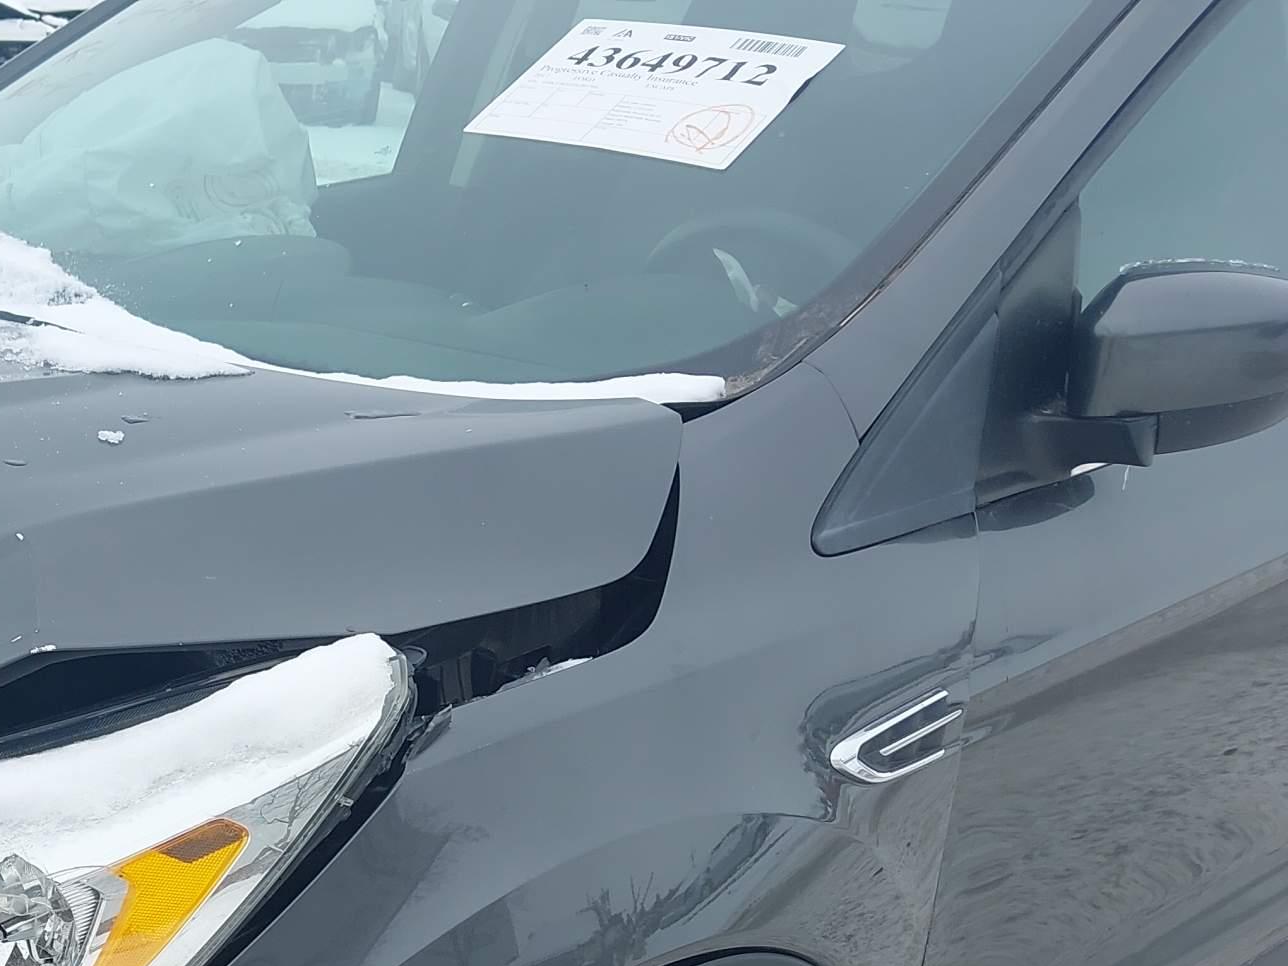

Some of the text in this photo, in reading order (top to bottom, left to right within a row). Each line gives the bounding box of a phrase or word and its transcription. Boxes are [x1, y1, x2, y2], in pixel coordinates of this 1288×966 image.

[540, 64, 599, 76] Progressive
[599, 68, 642, 80] Casualty
[647, 73, 699, 86] Insurance
[567, 45, 777, 86] 43649712
